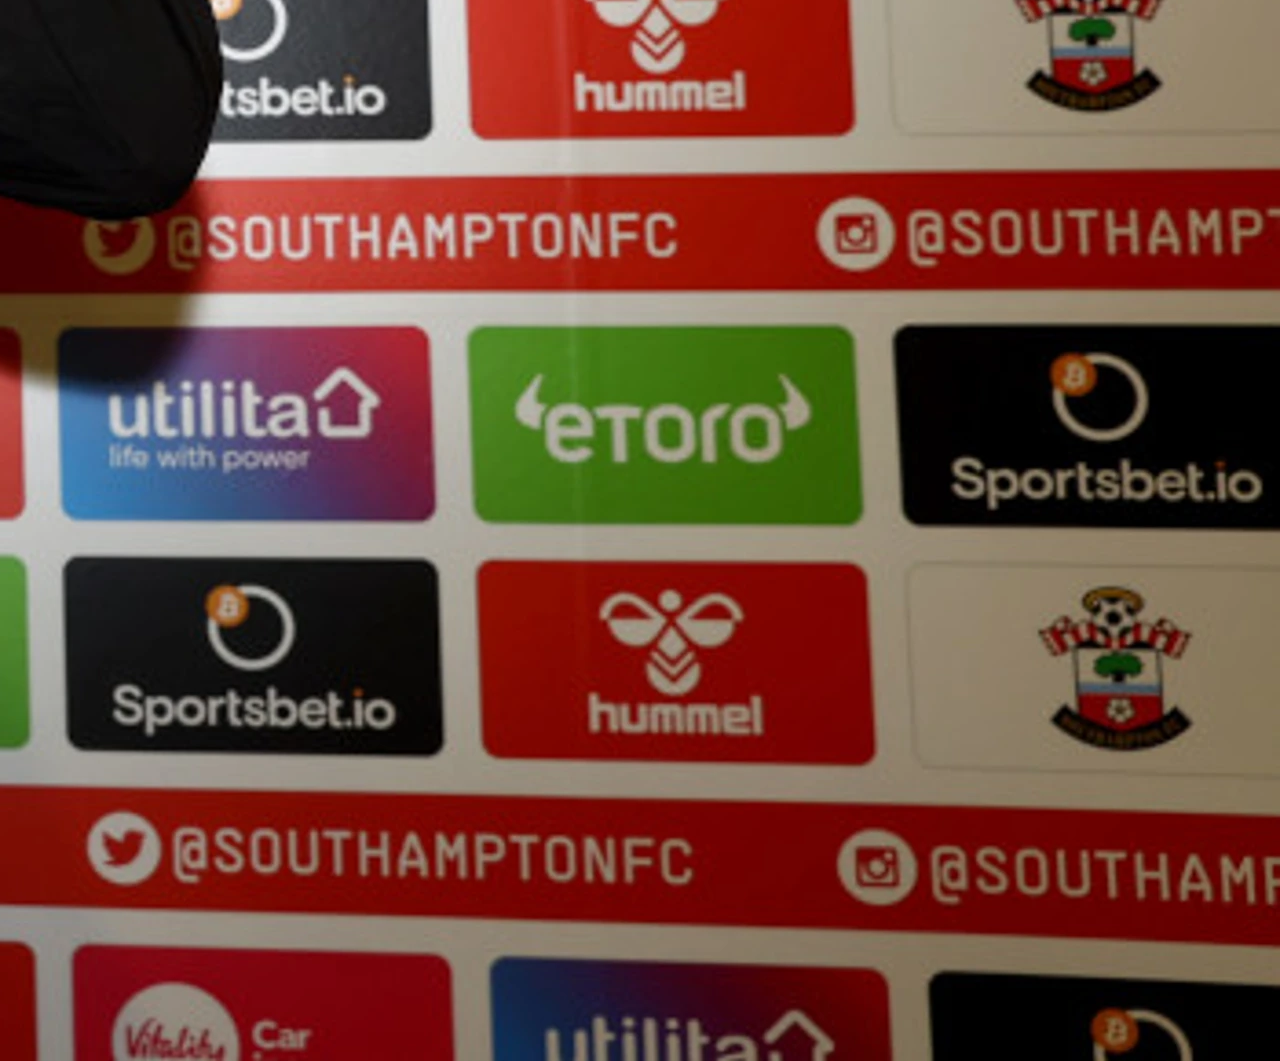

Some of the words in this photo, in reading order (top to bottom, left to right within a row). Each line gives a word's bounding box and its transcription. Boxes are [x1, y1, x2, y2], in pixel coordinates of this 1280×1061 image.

[574, 70, 745, 111] hummel
[167, 212, 676, 270] @SOUTHAMPTONFC
[109, 380, 309, 438] utilita
[109, 444, 150, 468] life
[156, 445, 215, 469] with
[221, 448, 309, 474] power
[952, 453, 1262, 509] Sportsbet.io
[113, 683, 395, 736] Sportsbet.io
[588, 690, 763, 735] hummel
[172, 826, 692, 884] @SOUTHAMPTONFC
[252, 1020, 311, 1051] Car
